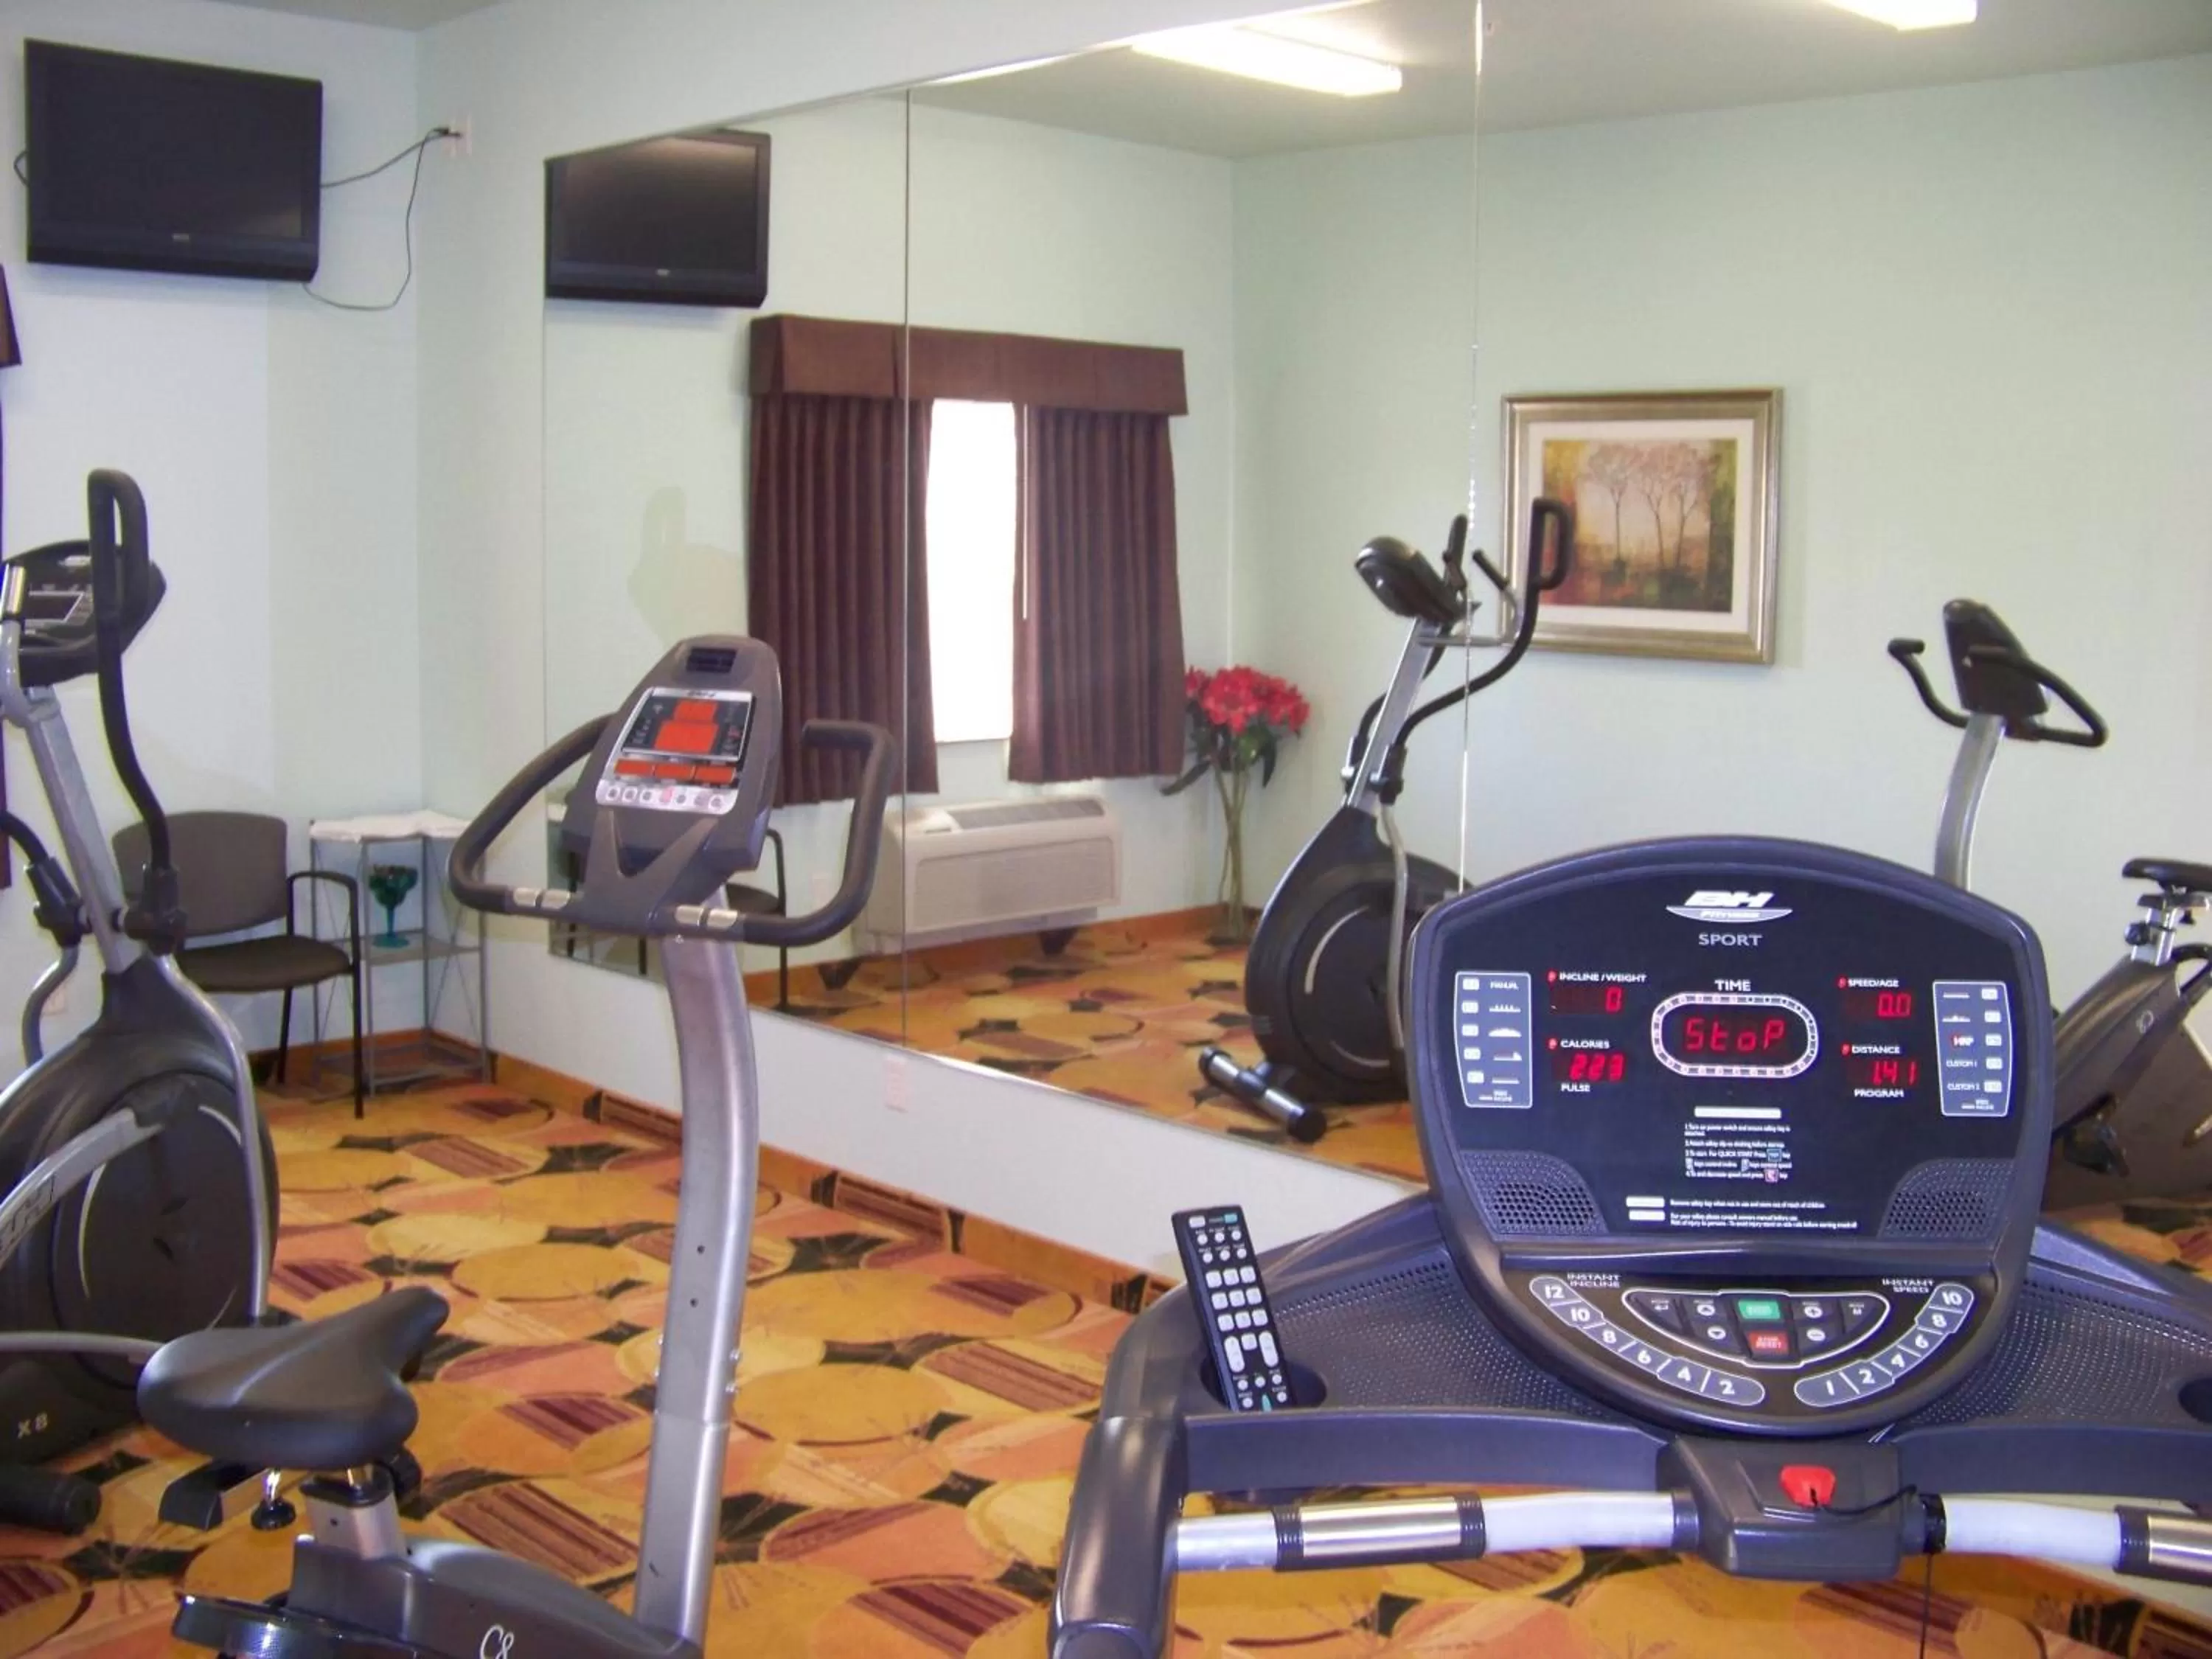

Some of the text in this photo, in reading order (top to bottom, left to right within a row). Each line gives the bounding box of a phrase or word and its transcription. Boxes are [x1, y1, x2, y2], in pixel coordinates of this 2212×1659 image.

[1684, 890, 1775, 907] BH
[1698, 933, 1763, 947] SPORT
[1559, 972, 1599, 981] INCLINE
[1714, 979, 1752, 992] TIME
[1605, 986, 1622, 1013] 0
[1560, 1039, 1610, 1049] CALORIES
[1851, 1045, 1901, 1054] DISTANCE
[1561, 1082, 1591, 1093] PULSE
[1854, 1088, 1905, 1098] PROGRAM
[1567, 1273, 1621, 1281] INSTANT
[1570, 1280, 1621, 1288] INCLINE
[1882, 1279, 1935, 1287] INSTANT
[1544, 1285, 1735, 1395] 12 10 8 6 4 2
[1826, 1291, 1963, 1396] 10 8 6 4 2 1
